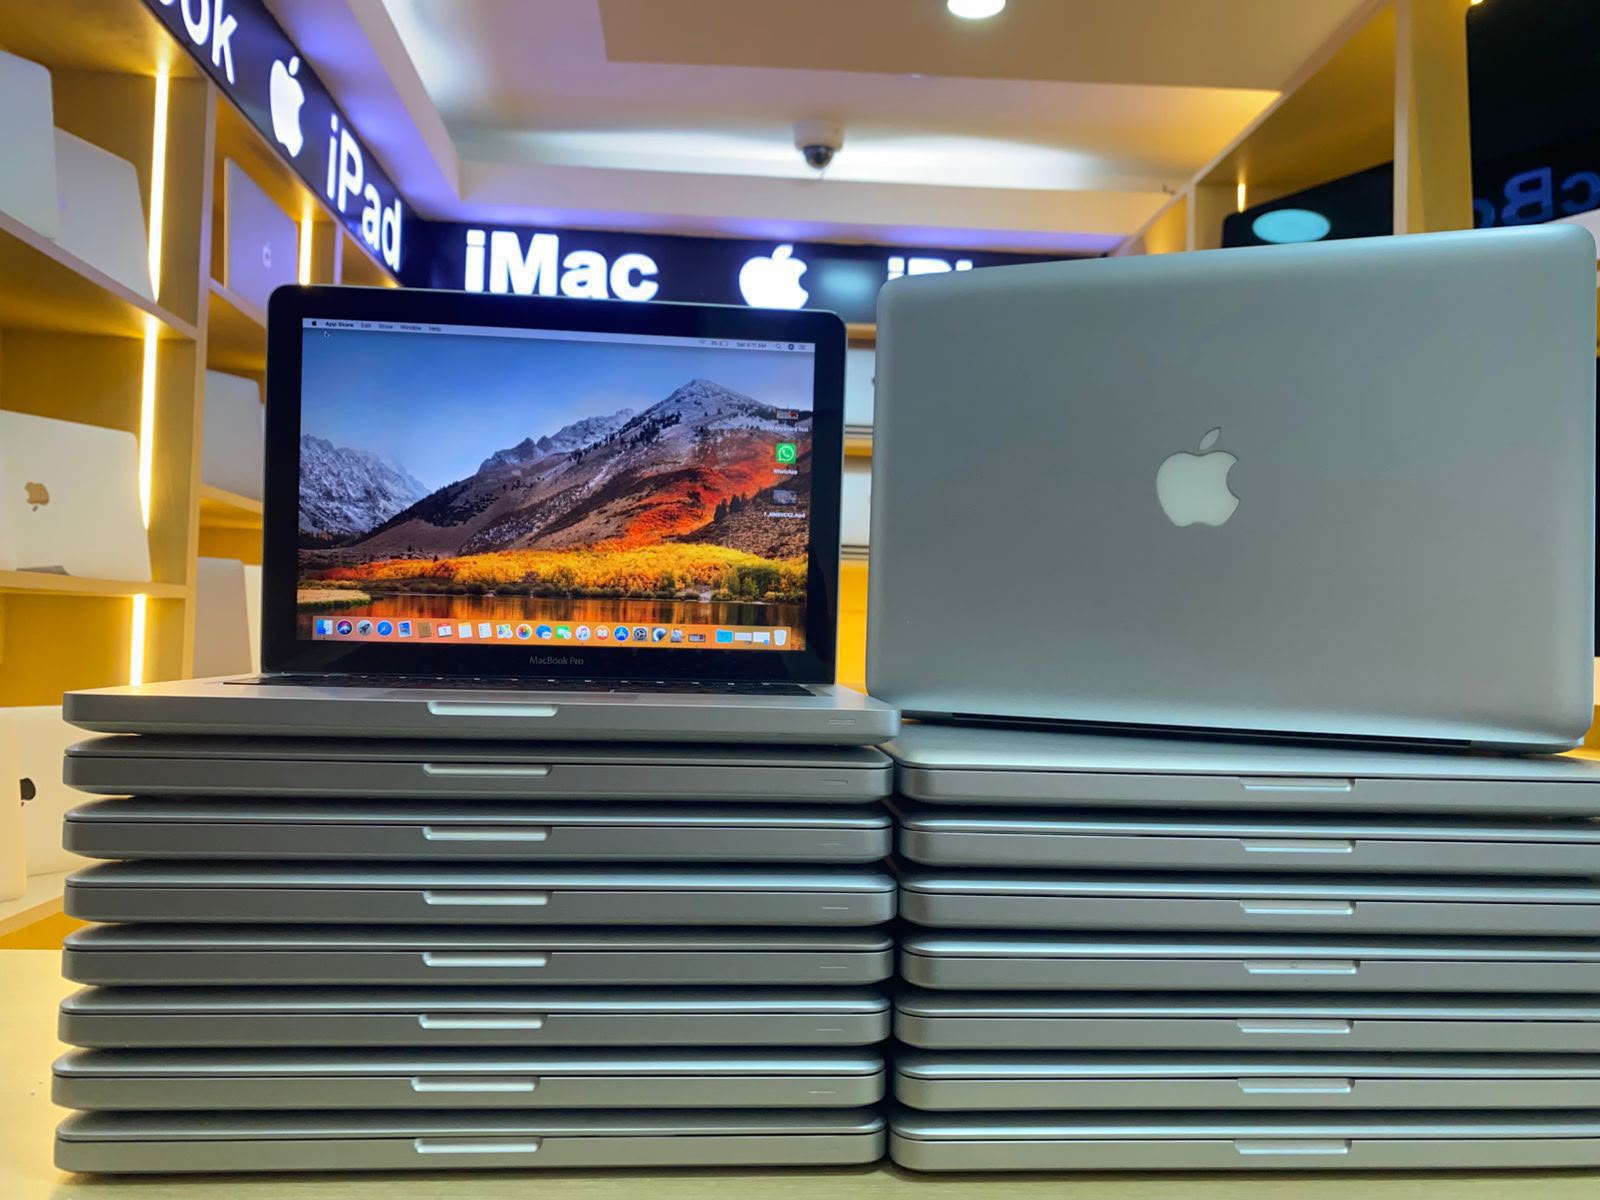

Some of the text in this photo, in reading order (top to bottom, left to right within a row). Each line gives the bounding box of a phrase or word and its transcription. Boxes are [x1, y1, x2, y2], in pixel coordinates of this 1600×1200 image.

[159, 0, 238, 85] ok
[326, 113, 401, 273] iPad
[465, 229, 659, 301] iMac
[529, 656, 584, 665] MacBook Pro
